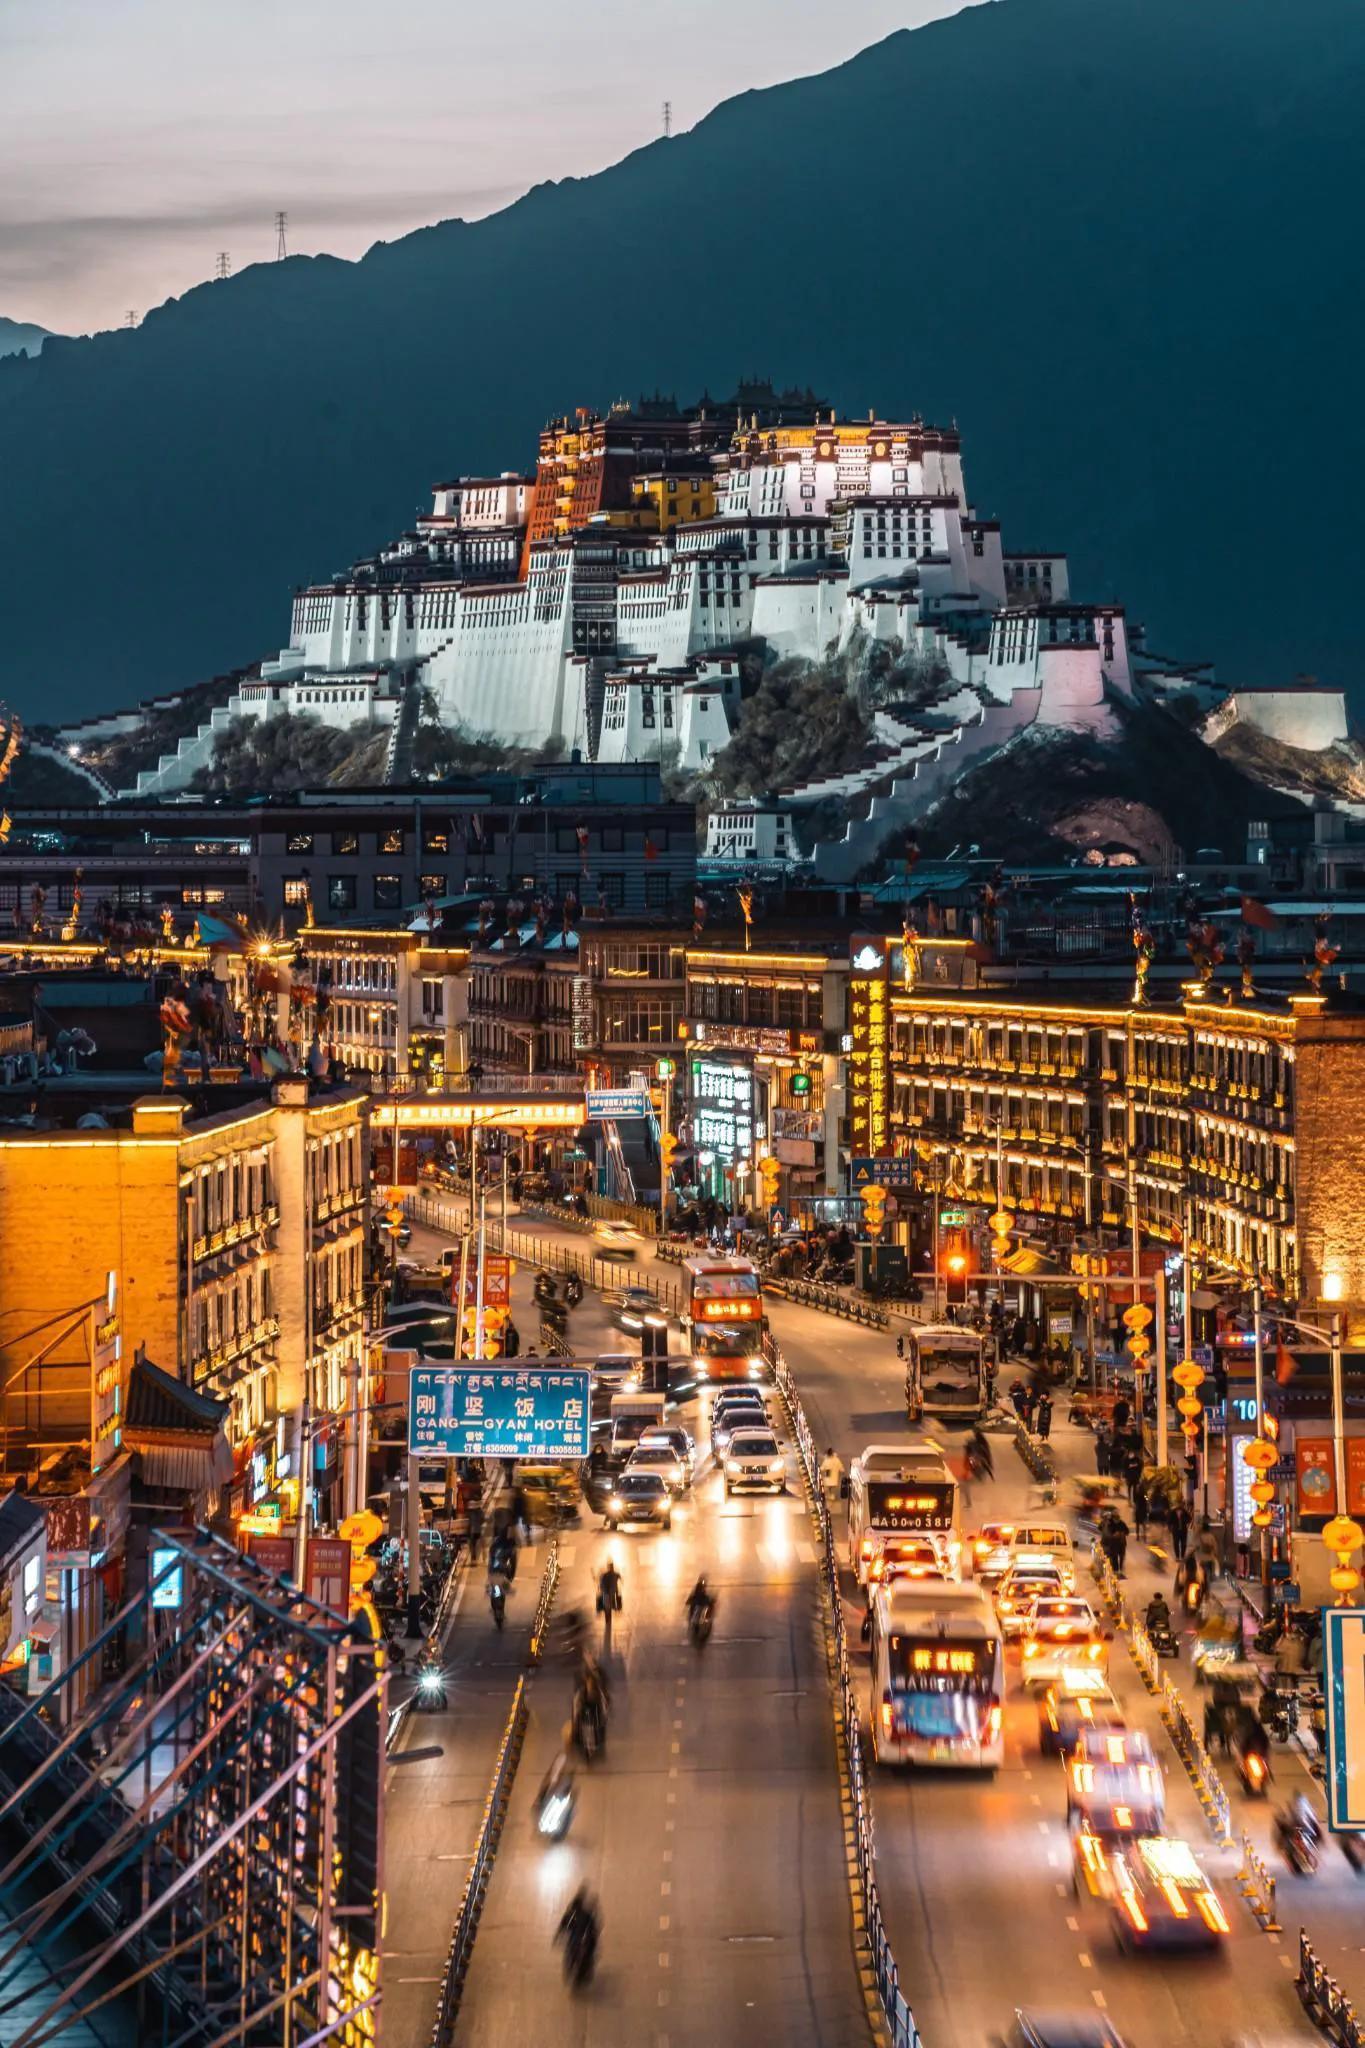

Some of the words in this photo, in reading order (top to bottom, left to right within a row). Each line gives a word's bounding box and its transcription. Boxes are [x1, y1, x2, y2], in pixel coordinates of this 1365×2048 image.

[417, 1395, 583, 1418] 刚坚饭店
[534, 1419, 583, 1431] HOTEL
[416, 1431, 435, 1440] 住宿
